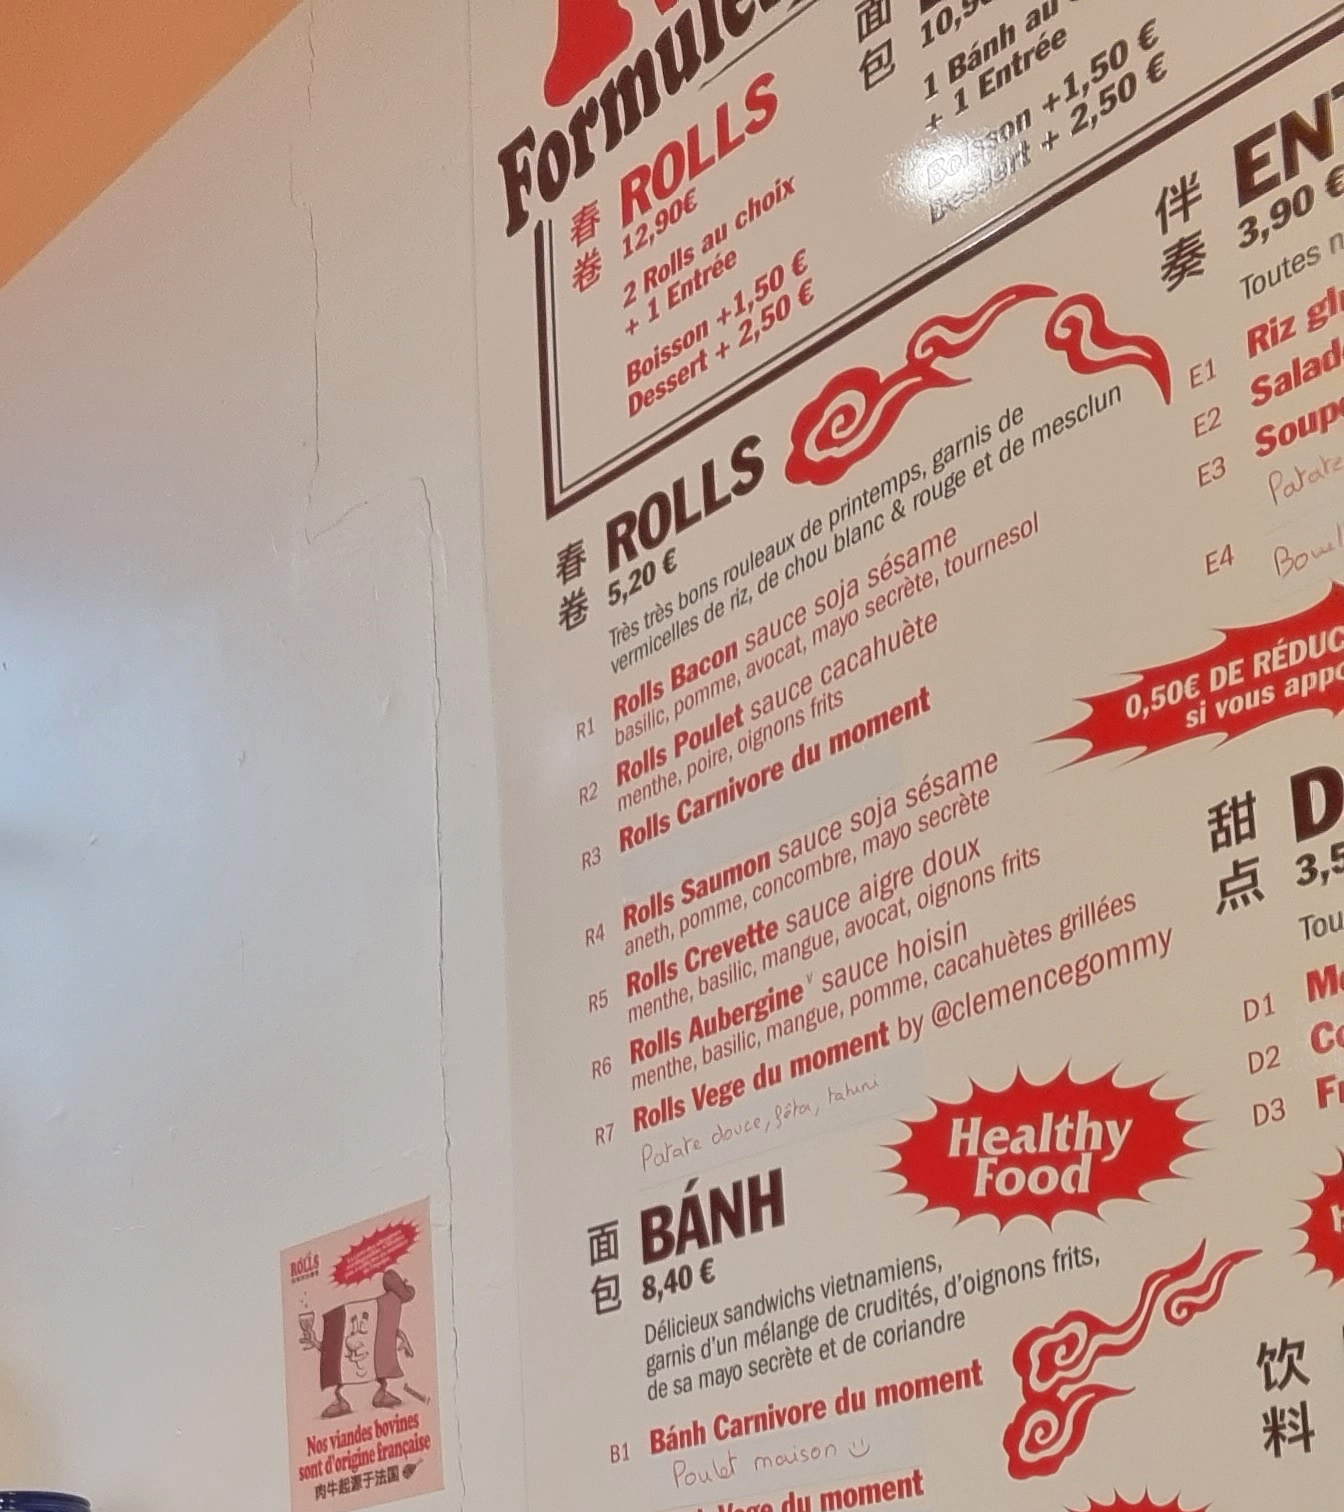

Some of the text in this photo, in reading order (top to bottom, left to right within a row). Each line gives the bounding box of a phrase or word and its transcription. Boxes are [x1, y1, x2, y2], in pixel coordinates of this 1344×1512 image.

[498, 0, 782, 238] Formule
[620, 72, 778, 228] ROLLS
[622, 186, 698, 260] 12,90€
[622, 175, 796, 310] 2 Rolls au choix
[1155, 170, 1207, 293] 伴奏
[1238, 184, 1314, 248] 3,90
[626, 247, 809, 388] Boisson +1,50 €
[1247, 315, 1296, 359] Riz
[1189, 336, 1344, 407] E1 Salad
[1255, 396, 1344, 457] Soup
[606, 435, 764, 573] ROLLS
[608, 406, 1024, 648] Très très bons rouleaux de printemps, garnis de
[555, 538, 589, 632] 春卷
[607, 546, 678, 607] 5,20 €
[613, 526, 957, 722] Rolls Bacon sauce soja sésame
[576, 716, 595, 741] R1
[1125, 673, 1201, 720] 0,50€
[1209, 658, 1244, 692] DE
[1185, 684, 1275, 728] si vous
[1207, 789, 1265, 916] 甜点
[633, 927, 1173, 1133] Rolls Vege du moment by @clemencegommy
[1243, 992, 1276, 1023] D1
[949, 1111, 1133, 1159] Healthy
[975, 1153, 1091, 1199] Food
[640, 1168, 785, 1264] BÁNH
[644, 1253, 943, 1345] Délicieux sandwichs vietnamiens,
[306, 1412, 420, 1457] Nos viandes bovines
[649, 1358, 984, 1456] Bánh Carnivore du moment
[1256, 1337, 1315, 1458] 饮料
[299, 1431, 431, 1482] sont d'origine française
[610, 1443, 630, 1463] B1
